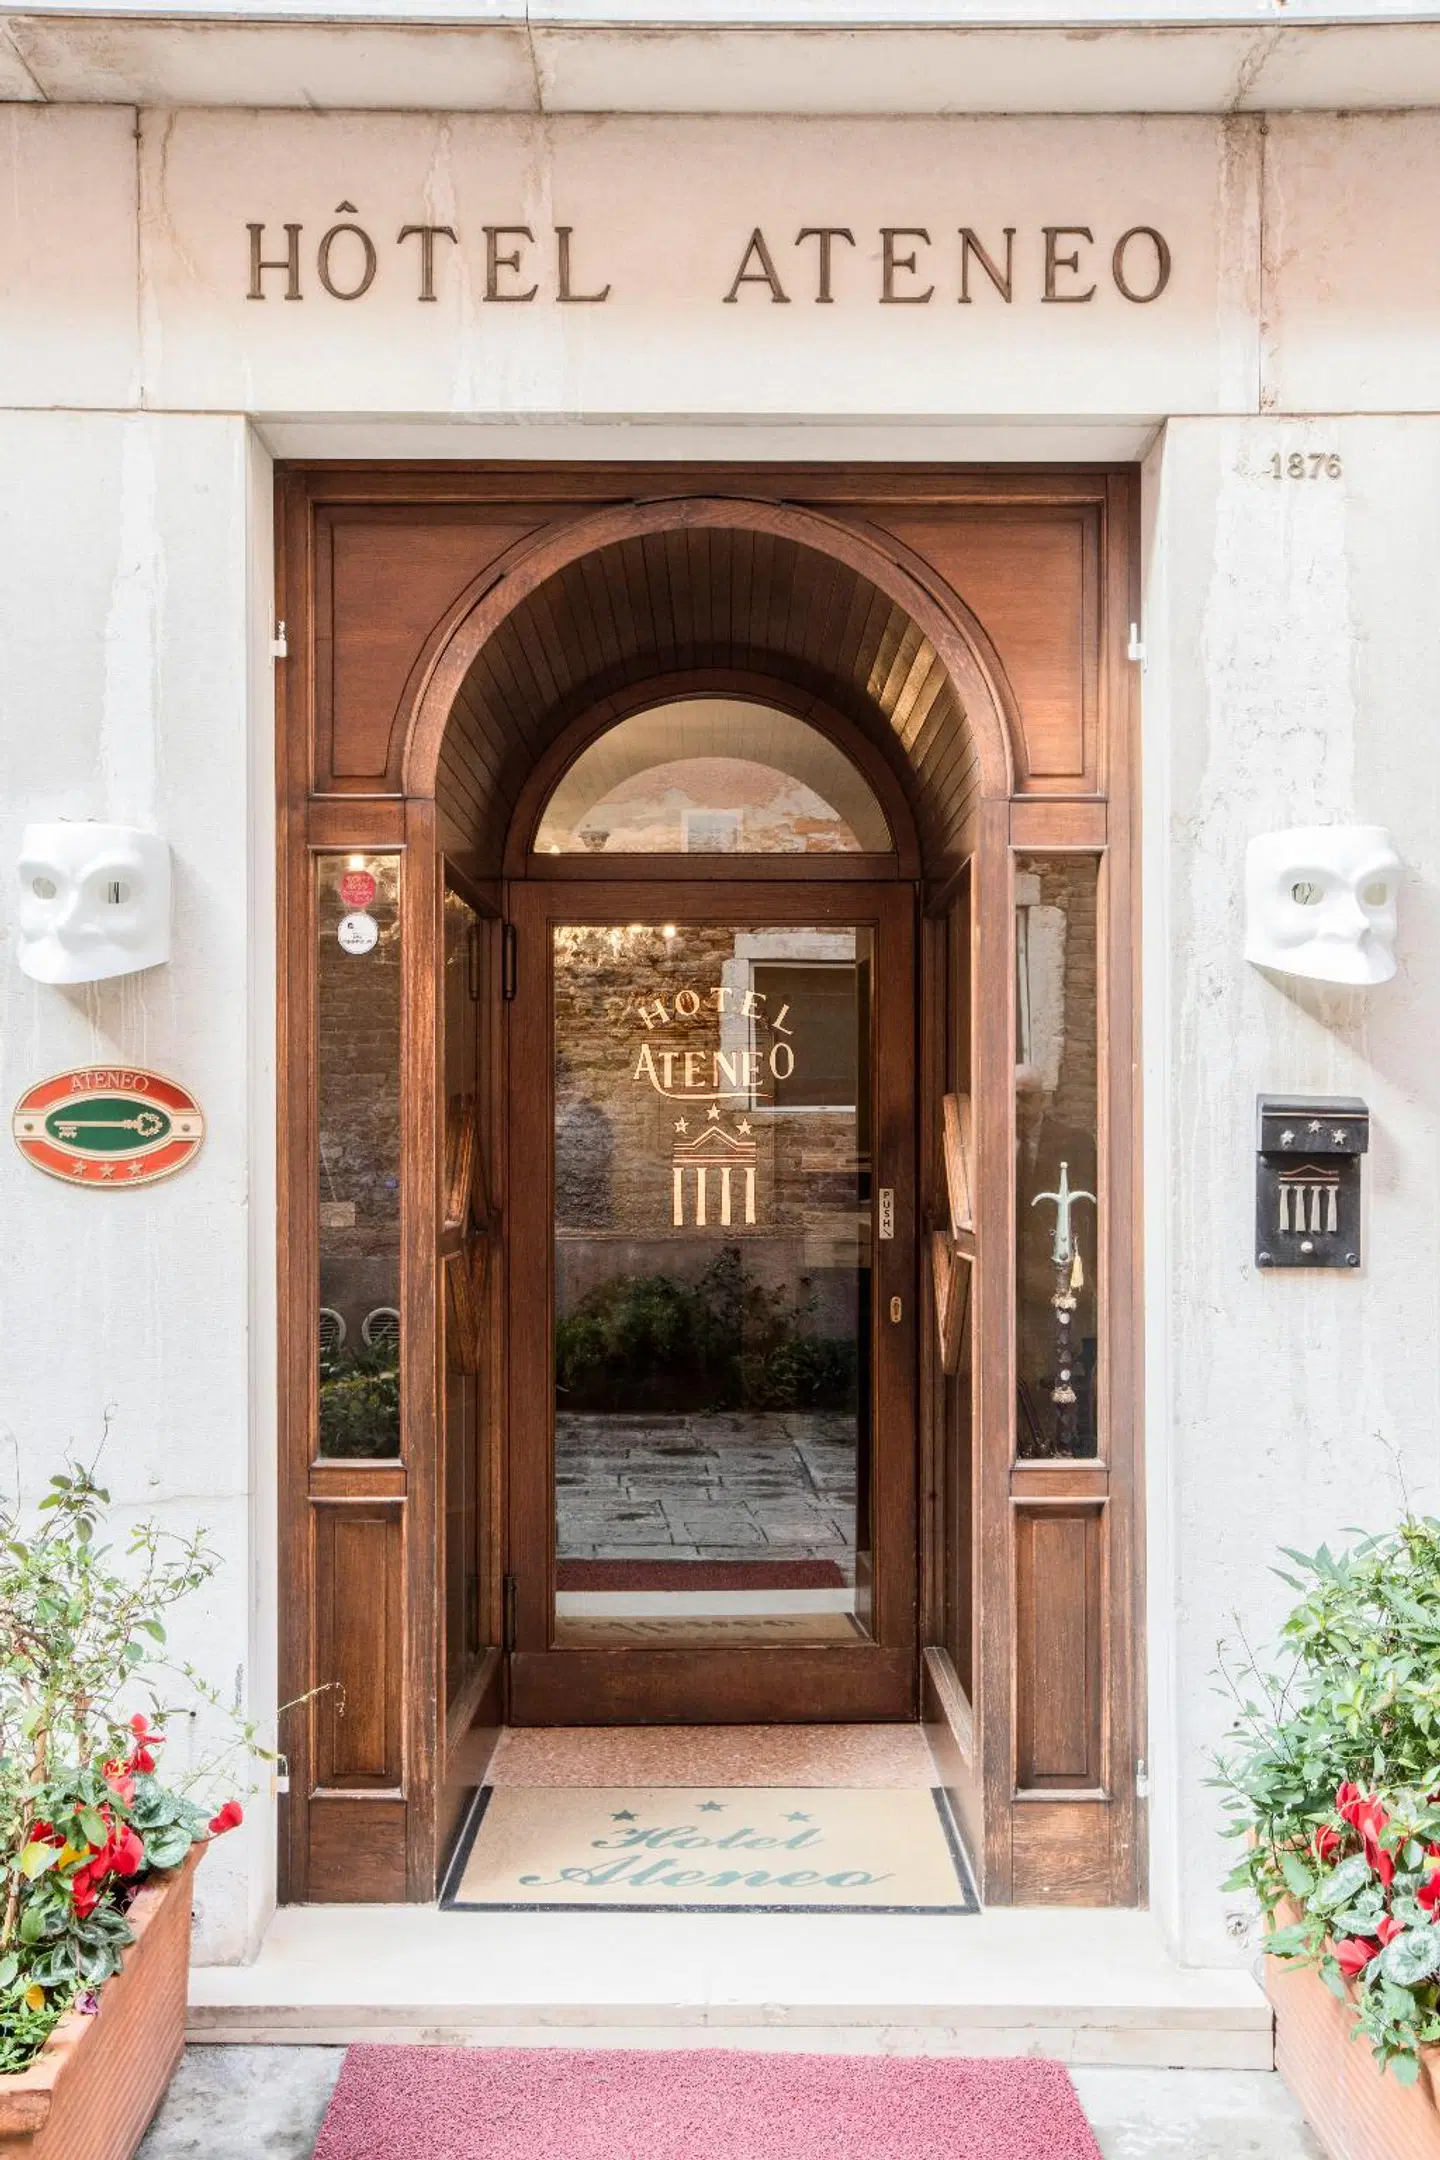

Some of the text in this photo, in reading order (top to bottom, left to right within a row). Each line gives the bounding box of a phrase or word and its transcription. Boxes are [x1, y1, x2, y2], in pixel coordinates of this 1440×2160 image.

[246, 201, 1172, 304] HÔTEL ATENEO
[1270, 452, 1341, 479] 1876
[638, 987, 793, 1035] HOTEL
[71, 1071, 149, 1092] ATENEO
[633, 1043, 795, 1099] ATENEO
[591, 1826, 826, 1850] Hotel
[518, 1855, 896, 1887] Ateneo
